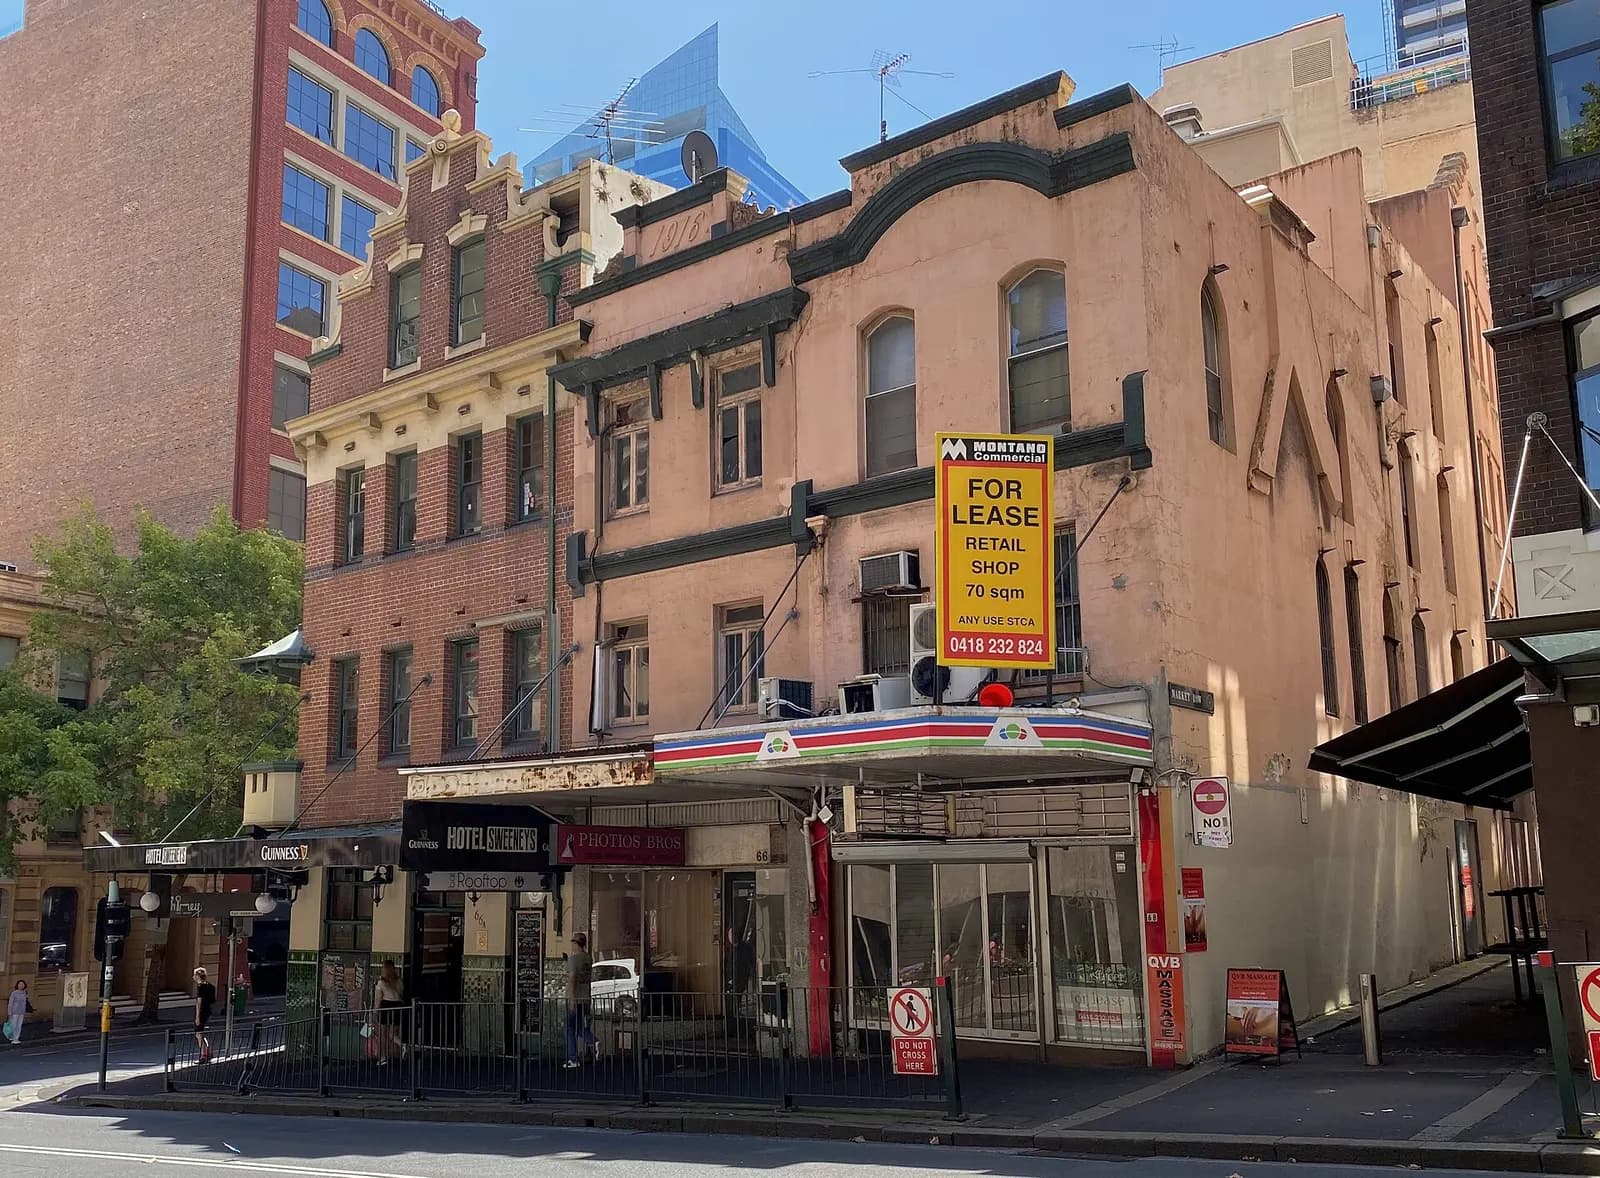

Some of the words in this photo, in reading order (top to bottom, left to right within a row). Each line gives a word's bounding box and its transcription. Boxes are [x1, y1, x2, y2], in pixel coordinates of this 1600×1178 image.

[649, 210, 705, 258] 1916
[973, 441, 1046, 454] MONTANO
[973, 452, 1046, 464] Commercial
[968, 478, 1022, 500] FOR
[952, 504, 1040, 527] LEASE
[966, 537, 1026, 552] RETAIL
[971, 560, 1020, 575] SHOP
[965, 584, 985, 598] 70
[990, 587, 1025, 601] sqm
[958, 615, 980, 625] ANY
[983, 616, 1004, 626] USE
[1007, 617, 1035, 627] STCA
[950, 637, 984, 653] 0418
[988, 638, 1014, 654] 232
[1018, 639, 1043, 655] 824
[1203, 818, 1221, 828] NO
[408, 839, 440, 850] GUINNESS
[447, 826, 487, 851] HOTEL
[488, 827, 538, 852] SWEENEYS
[578, 831, 642, 850] PHOTIOS
[647, 834, 682, 850] BROS
[145, 848, 162, 865] HOTEL
[261, 845, 299, 861] GUINNESS
[756, 850, 768, 862] 66
[457, 872, 508, 889] Rooftop
[1147, 956, 1181, 969] QVB
[1156, 970, 1175, 1038] MASSAGE
[899, 1041, 910, 1049] DO
[912, 1041, 927, 1049] NOT
[902, 1051, 927, 1059] CROSS
[905, 1062, 925, 1071] HERE
